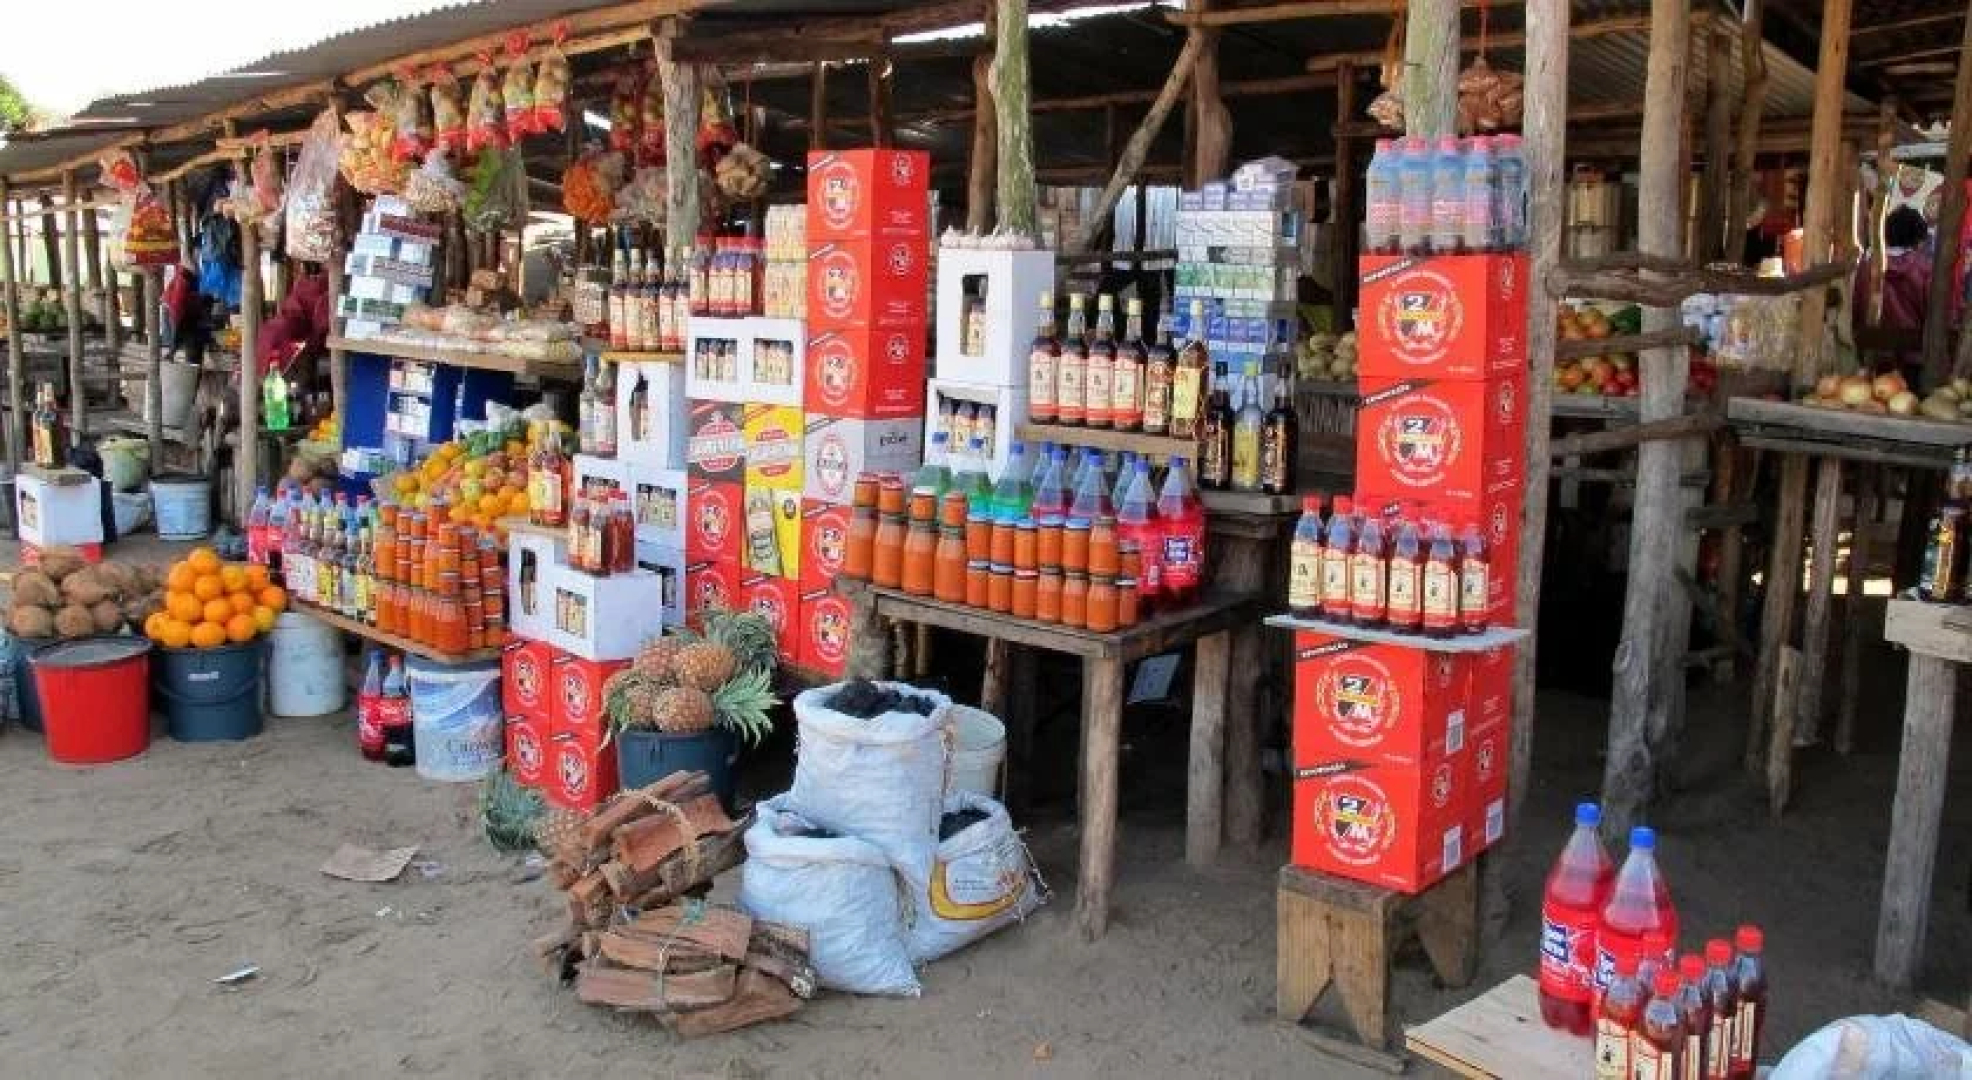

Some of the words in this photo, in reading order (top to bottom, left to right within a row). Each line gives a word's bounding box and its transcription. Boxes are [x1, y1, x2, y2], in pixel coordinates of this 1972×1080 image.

[1406, 295, 1424, 310] 2
[1407, 419, 1423, 433] 2
[1346, 678, 1363, 694] 2
[1342, 797, 1358, 813] 2
